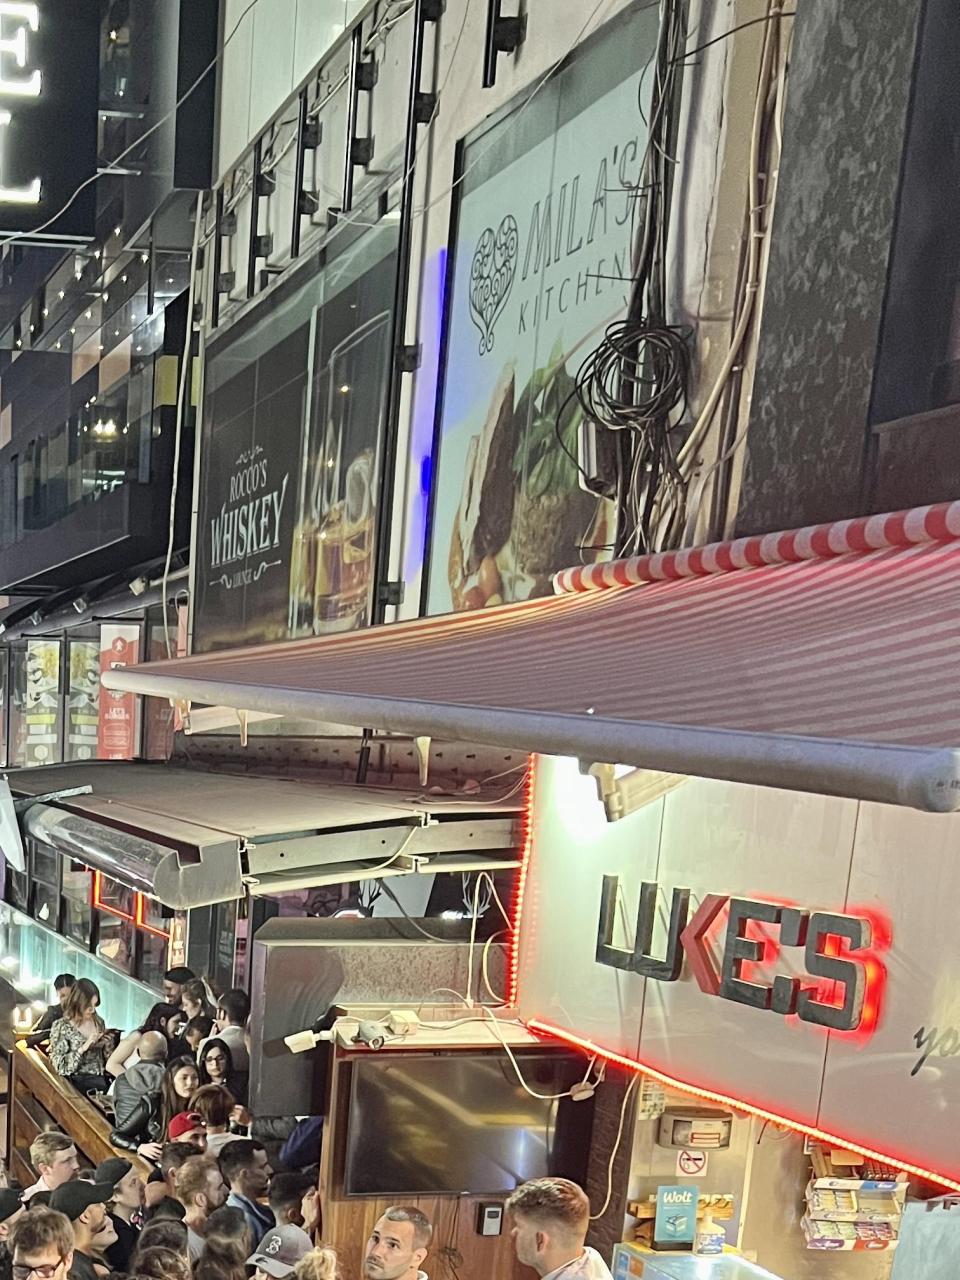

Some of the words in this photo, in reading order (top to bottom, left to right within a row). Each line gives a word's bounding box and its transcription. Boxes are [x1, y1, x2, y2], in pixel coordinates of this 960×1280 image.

[518, 246, 627, 335] KITCHEN
[211, 472, 289, 568] WHISKEY
[230, 458, 267, 502] ROCCO'S
[595, 874, 872, 1031] LUKE'S
[662, 1190, 693, 1204] Wolt
